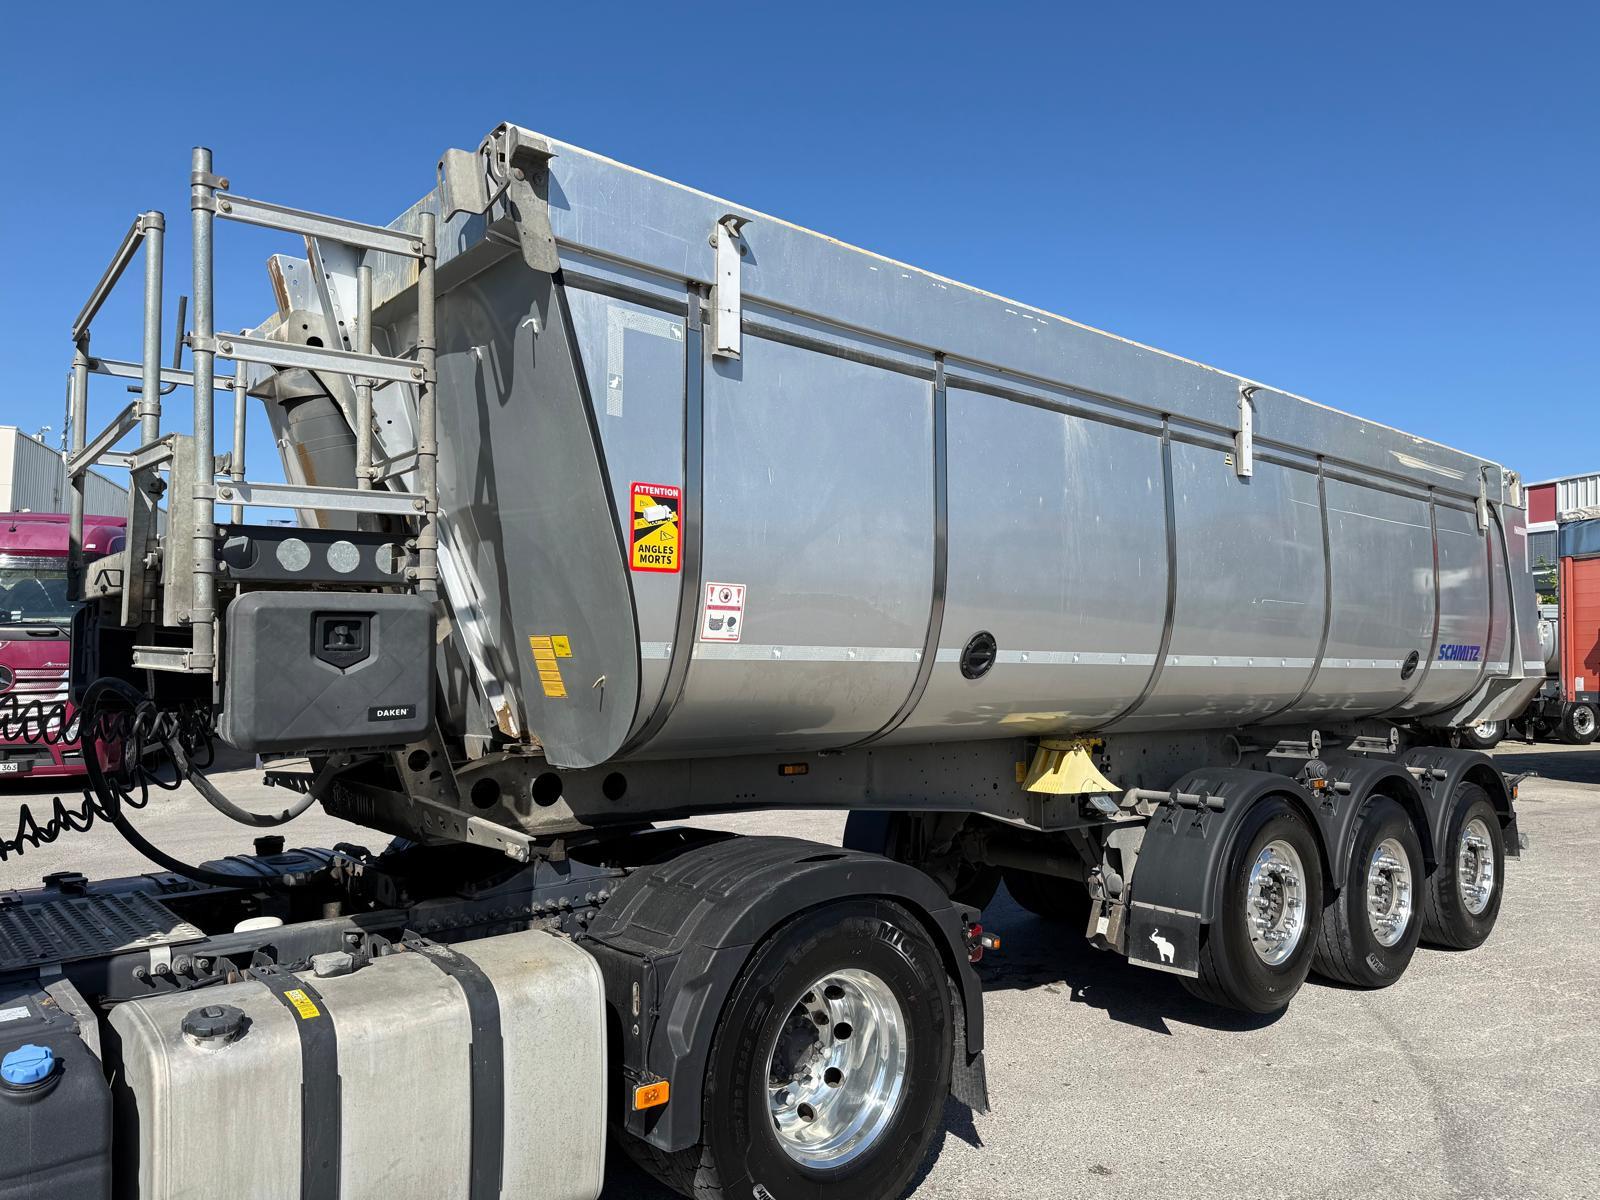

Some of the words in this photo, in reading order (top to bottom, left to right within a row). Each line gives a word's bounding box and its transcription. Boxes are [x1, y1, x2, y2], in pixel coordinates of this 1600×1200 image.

[634, 485, 679, 497] ATTENTION
[638, 544, 674, 555] ANGLES
[639, 554, 672, 565] MORTS
[1438, 644, 1481, 661] SCHMITZ
[376, 708, 407, 717] DAKEN
